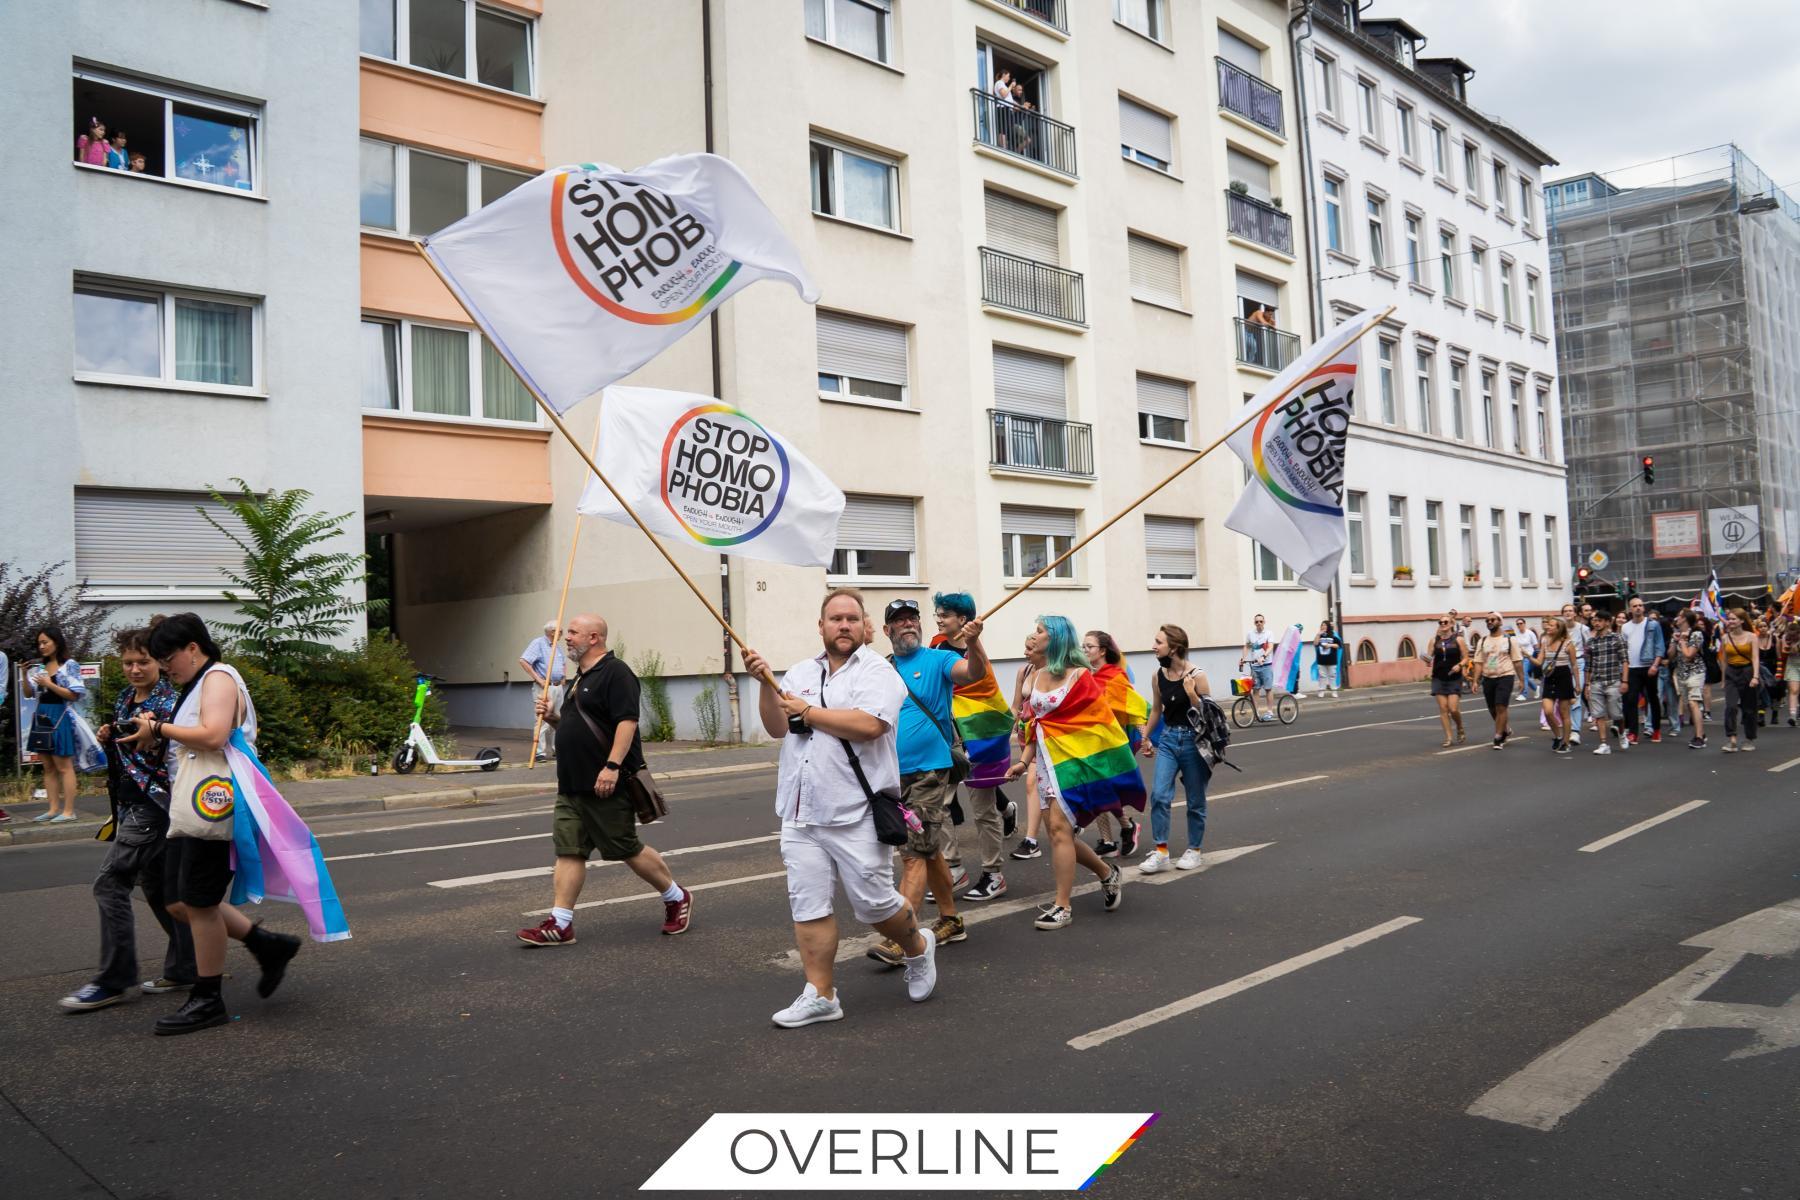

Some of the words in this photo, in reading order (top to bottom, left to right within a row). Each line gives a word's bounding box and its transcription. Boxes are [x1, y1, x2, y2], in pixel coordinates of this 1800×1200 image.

[568, 178, 641, 218] ST
[573, 188, 678, 271] HOM
[600, 213, 705, 303] PHOB
[690, 244, 716, 269] ENOUG
[692, 417, 770, 459] STOP
[1274, 396, 1344, 507] PHOBIA
[675, 438, 776, 493] HOMO
[668, 469, 765, 519] PHOBIA
[756, 581, 767, 591] 30
